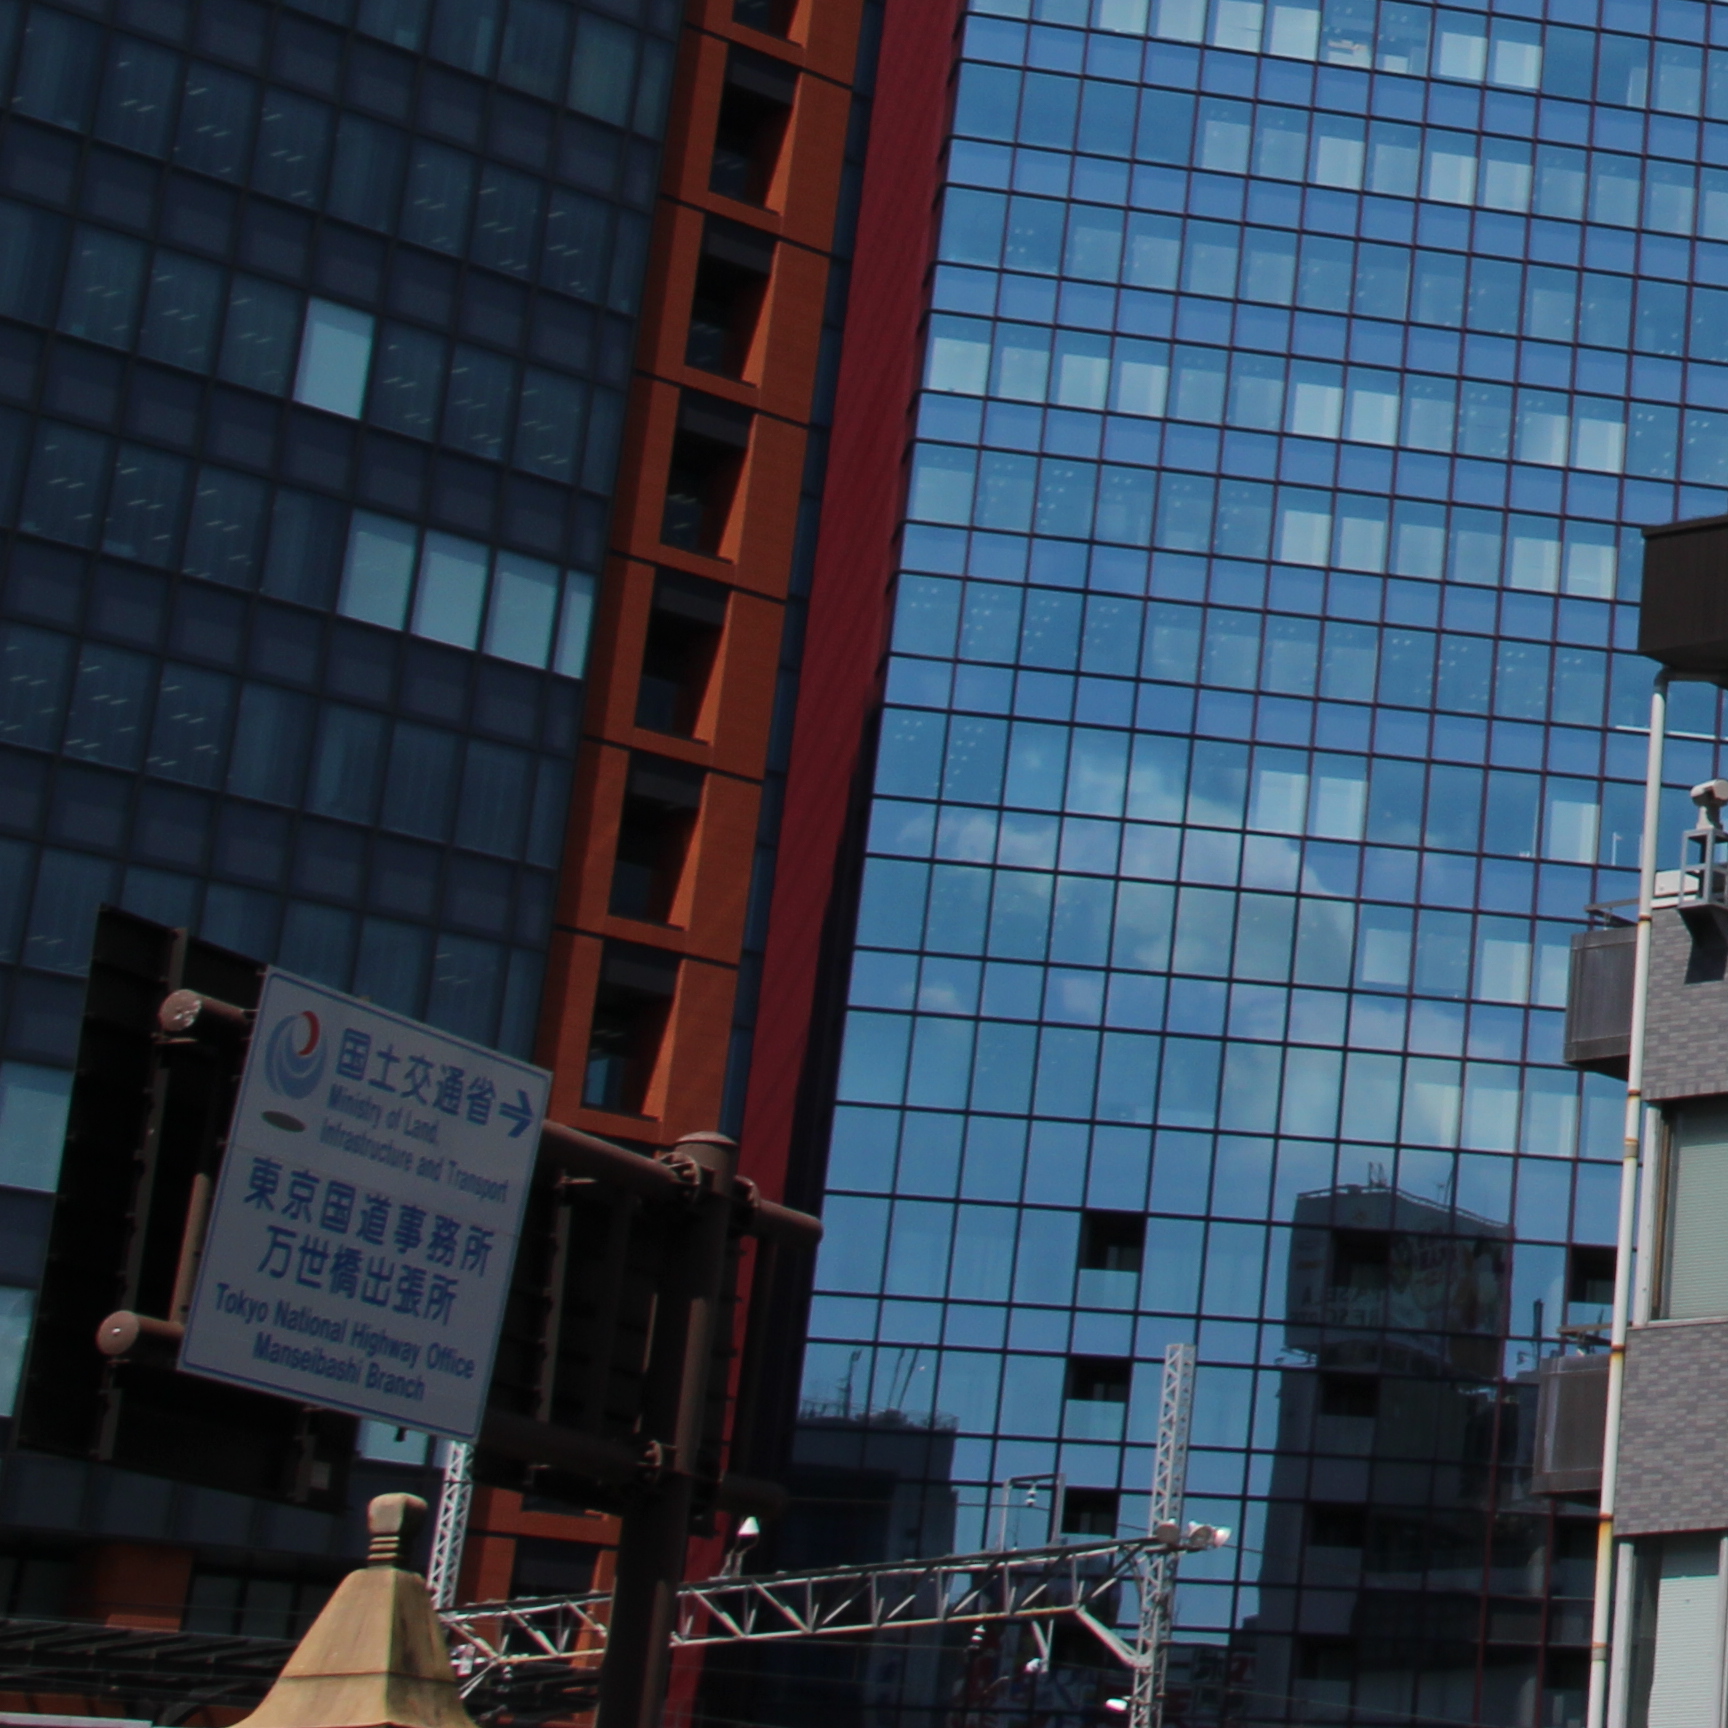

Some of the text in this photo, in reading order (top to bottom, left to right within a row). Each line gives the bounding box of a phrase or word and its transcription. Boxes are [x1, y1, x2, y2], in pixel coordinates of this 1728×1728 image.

[327, 1083, 382, 1129] Ministry
[386, 1107, 401, 1129] of
[336, 1027, 497, 1126] 国土交通省
[319, 1117, 509, 1203] Infrastructure and Transport
[244, 1156, 495, 1277] 東京国道事務所
[257, 1224, 458, 1325] 万世橋出張所
[215, 1282, 476, 1379] Tokyo National Highway Office
[253, 1331, 426, 1401] Manseibashi Branch
